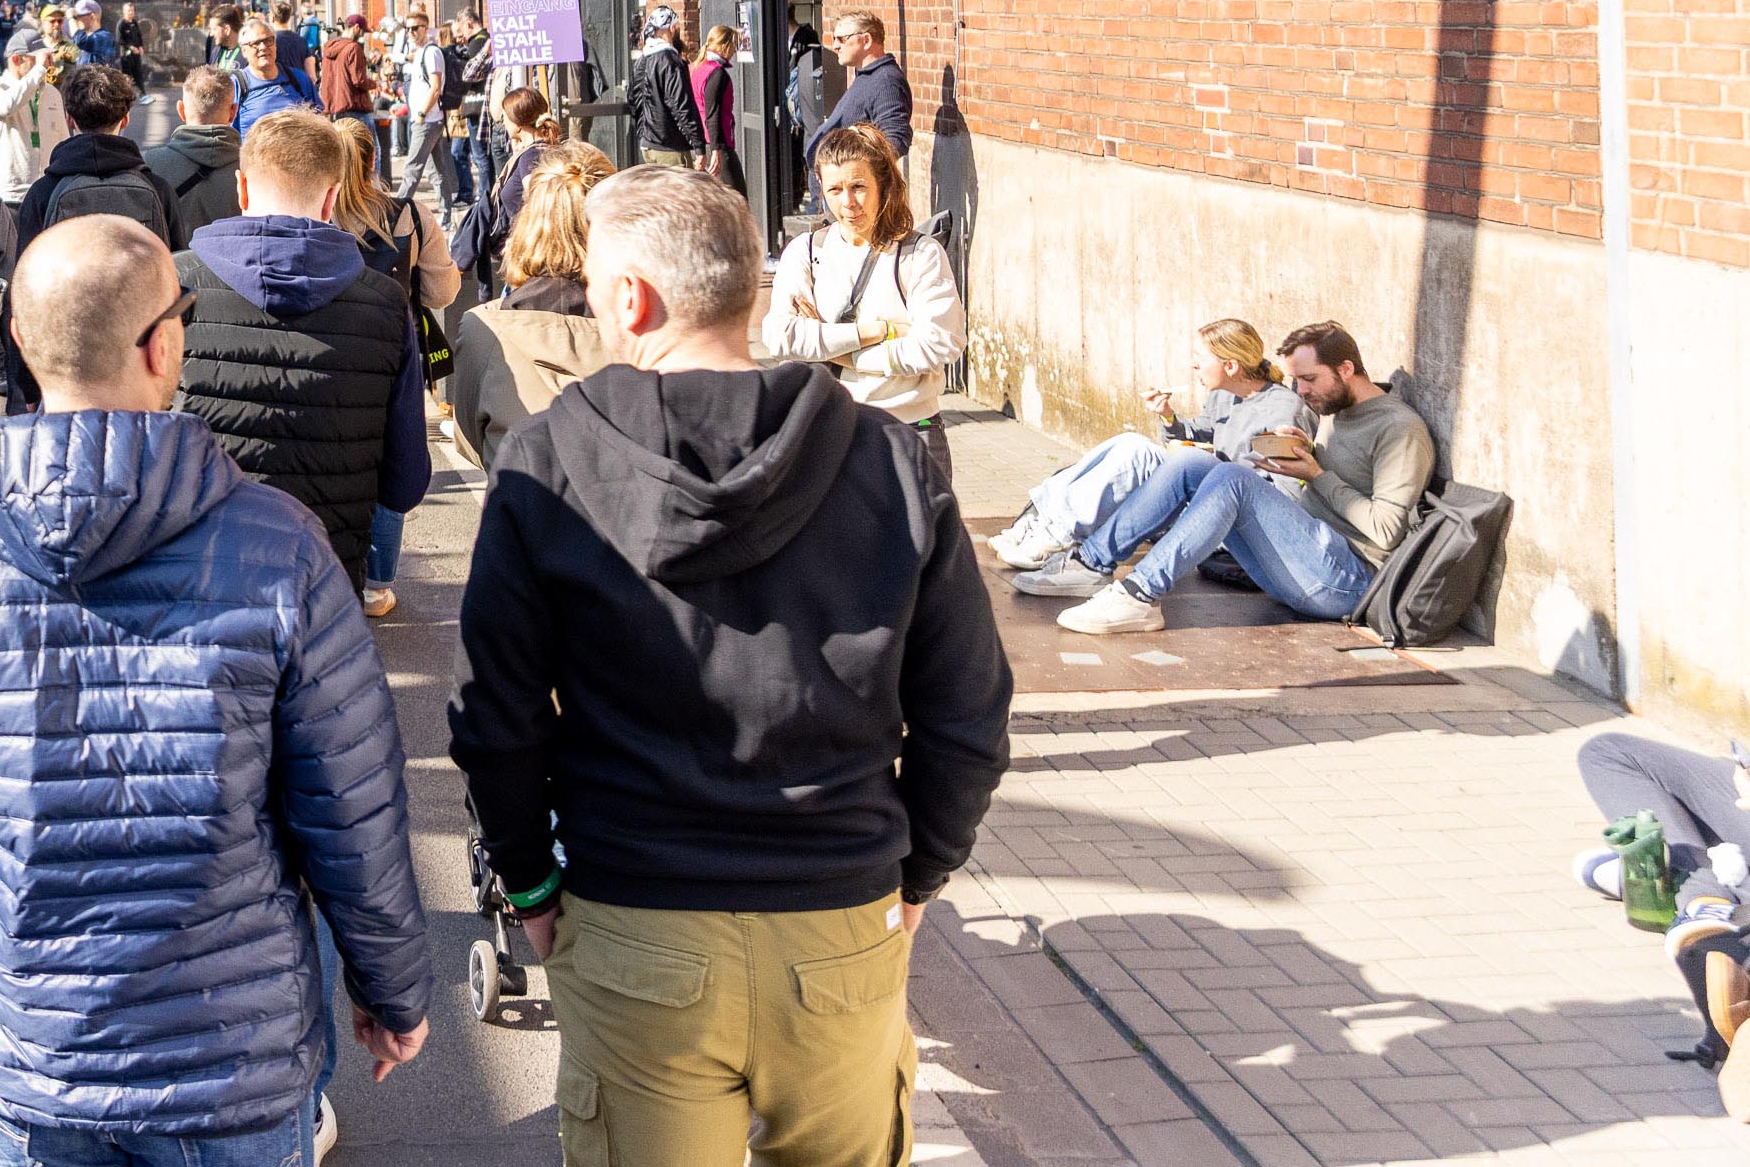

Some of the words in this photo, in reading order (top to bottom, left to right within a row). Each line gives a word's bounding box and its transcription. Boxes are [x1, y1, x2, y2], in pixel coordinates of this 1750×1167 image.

[491, 15, 537, 33] KALT
[493, 30, 553, 49] STAHL
[495, 46, 554, 65] HALLE
